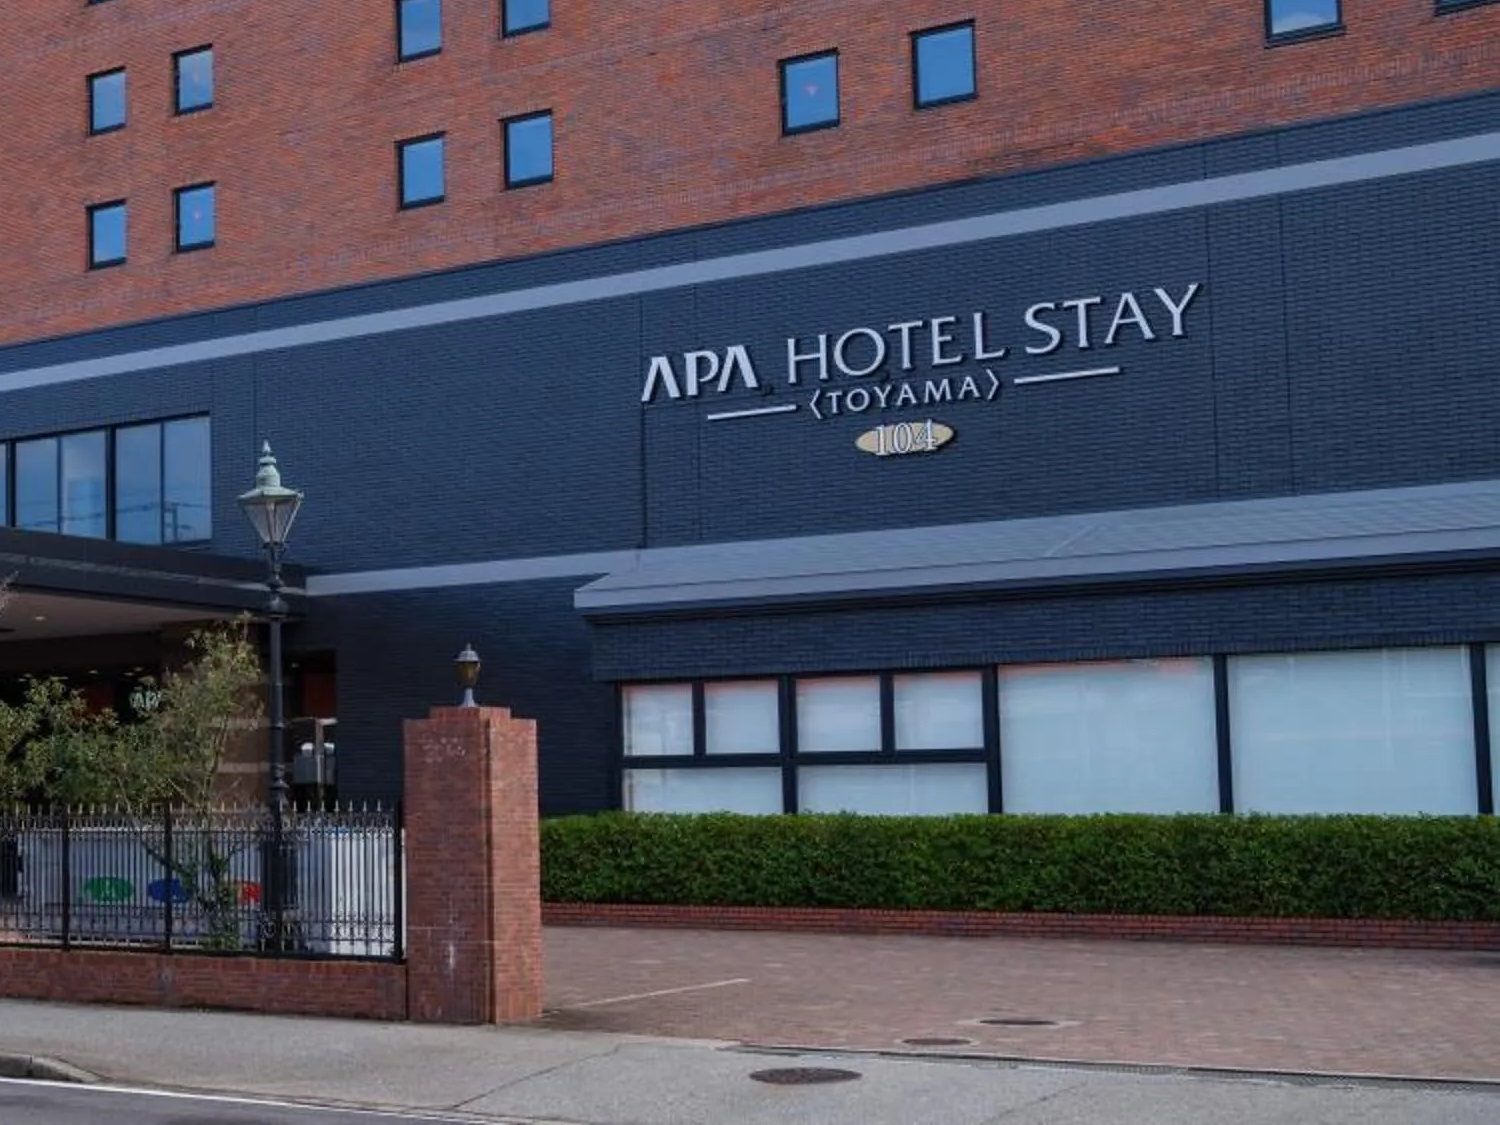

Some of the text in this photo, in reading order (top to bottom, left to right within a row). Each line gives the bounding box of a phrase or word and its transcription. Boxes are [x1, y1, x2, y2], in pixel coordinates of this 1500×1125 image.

[641, 283, 1199, 402] APA HOTEL STAY
[874, 418, 940, 456] 104
